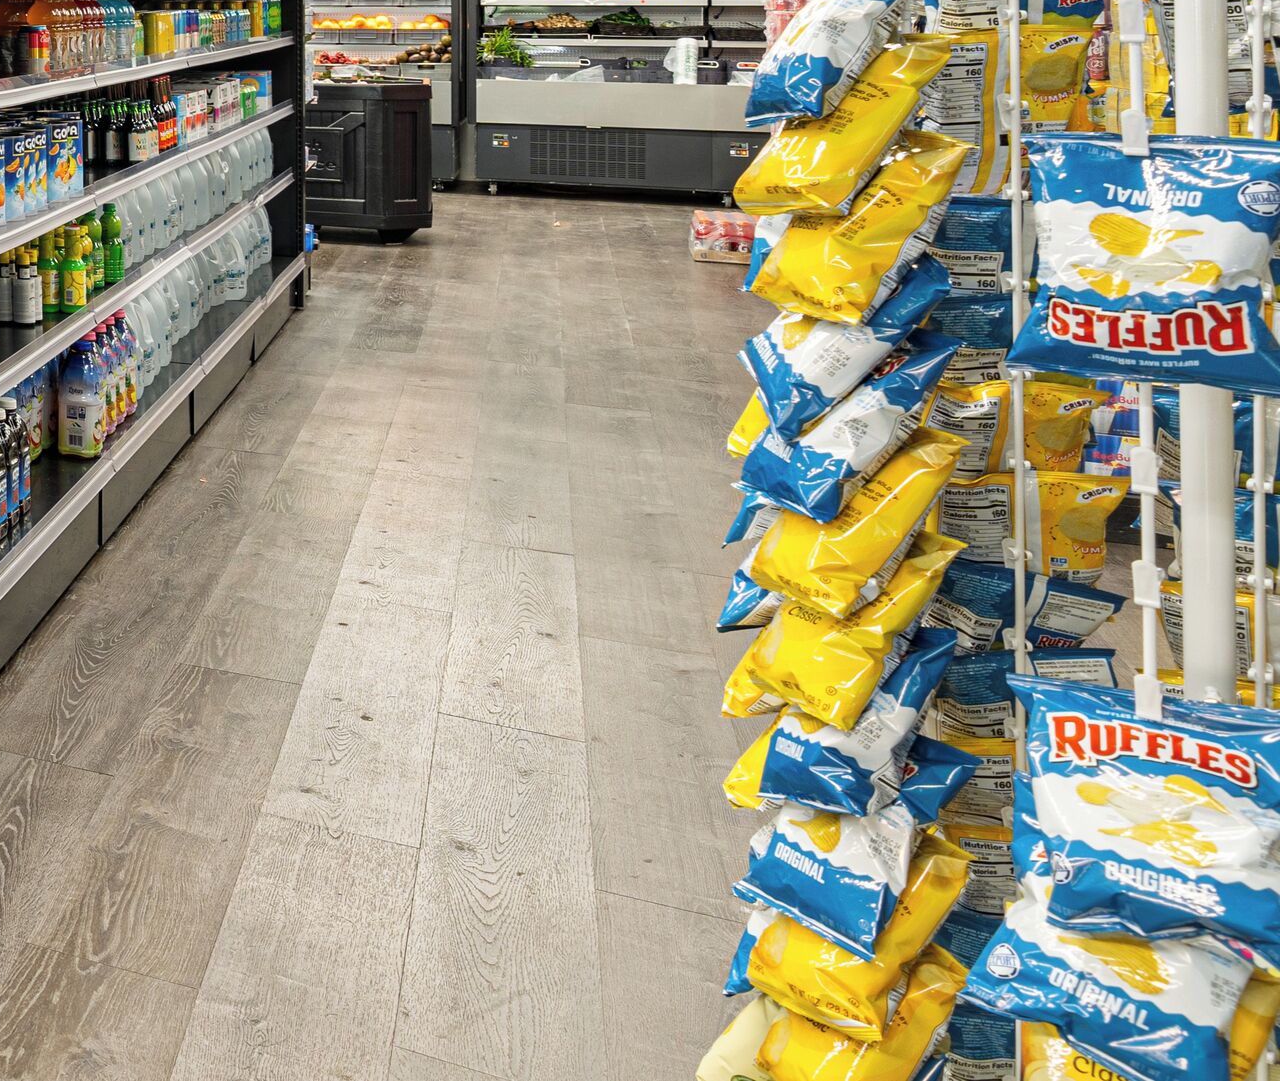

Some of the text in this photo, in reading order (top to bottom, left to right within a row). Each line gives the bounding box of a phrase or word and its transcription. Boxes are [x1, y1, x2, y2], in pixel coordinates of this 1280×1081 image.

[940, 20, 973, 28] Calories
[1049, 35, 1080, 51] CRISPY
[965, 68, 982, 77] 160
[882, 90, 890, 98] BY
[1033, 89, 1075, 103] YUMMY
[895, 196, 904, 206] BY
[931, 251, 971, 261] Nutrition
[977, 279, 996, 288] 160
[1051, 301, 1249, 352] RUFFLES
[980, 371, 1001, 381] 160
[1063, 399, 1092, 412] CRISPY
[1116, 396, 1139, 406] Bull
[978, 422, 995, 430] 160
[1045, 449, 1079, 463] YUMMY
[1093, 451, 1113, 461] Red
[944, 487, 1006, 496] Nutrition Facts
[1082, 486, 1113, 500] CRISPY
[942, 508, 1007, 519] Calories 160
[934, 598, 973, 621] Nutrition
[980, 706, 1008, 715] Facts
[941, 720, 977, 736] Calories
[1052, 715, 1256, 786] RUFFLES
[986, 757, 1010, 765] Facts
[994, 780, 1012, 790] 160
[774, 841, 825, 884] ORIGINAL
[1049, 971, 1150, 1029] ORIGINAL
[950, 1057, 1013, 1070] Nutrition Facts
